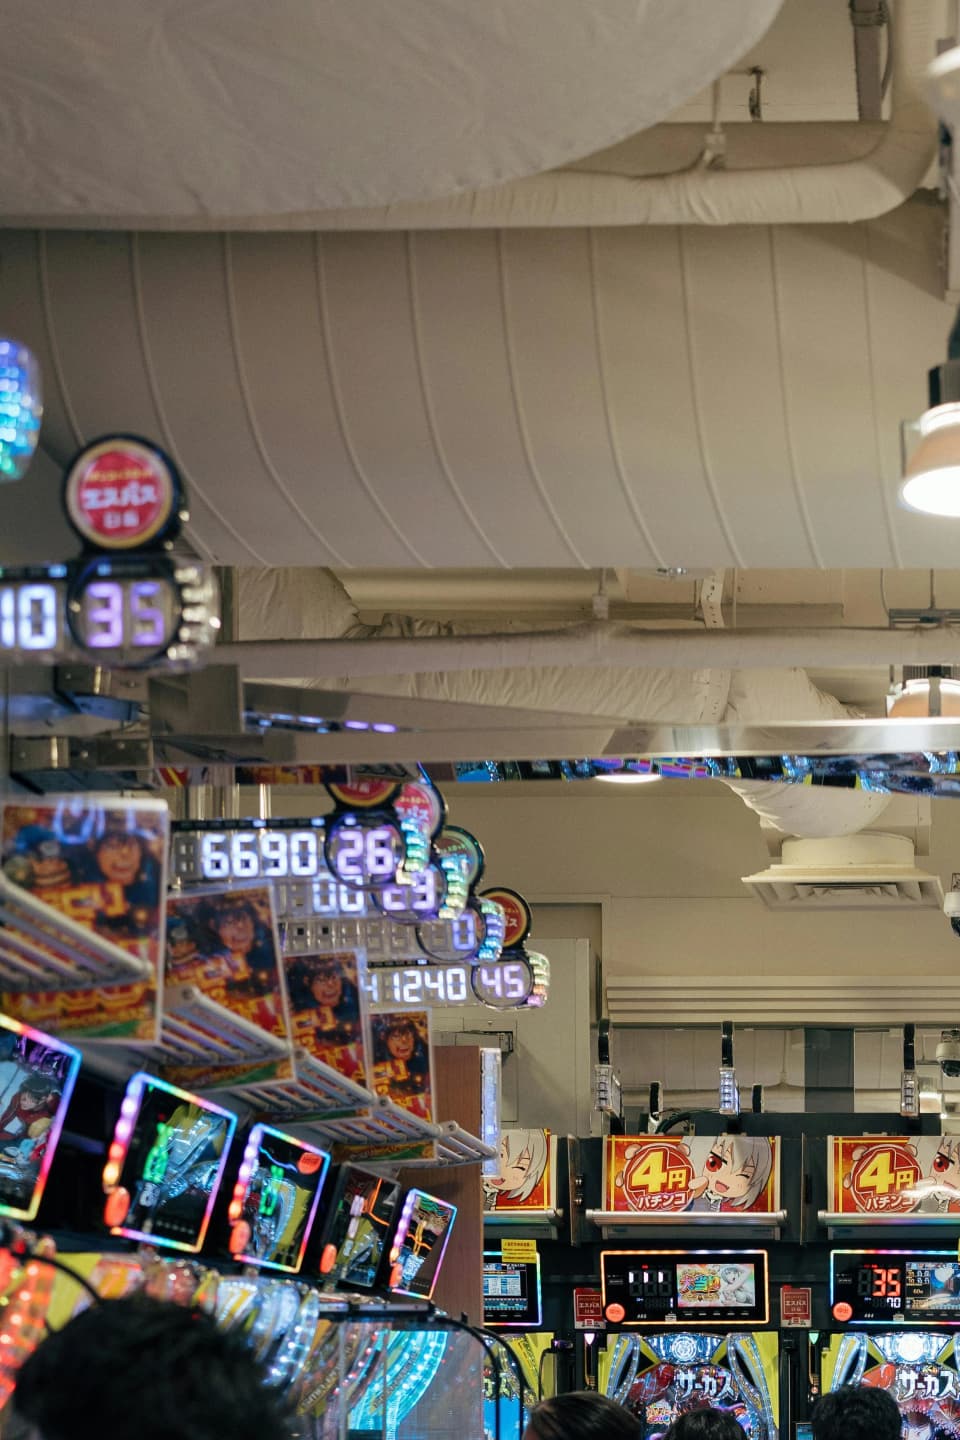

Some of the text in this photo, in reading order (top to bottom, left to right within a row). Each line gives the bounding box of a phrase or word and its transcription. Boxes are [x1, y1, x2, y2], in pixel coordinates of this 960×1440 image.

[86, 581, 164, 647] 35
[202, 831, 318, 878] 6690
[336, 829, 393, 877] 26
[480, 964, 525, 999] 45
[631, 1151, 687, 1192] 4円
[858, 1151, 915, 1194] 4円
[637, 1194, 687, 1209] パチンコ
[865, 1195, 915, 1211] パチンコ
[871, 1268, 901, 1297] 35
[887, 1297, 901, 1309] 70
[675, 1370, 736, 1399] サーカス
[897, 1370, 960, 1400] サーカス
